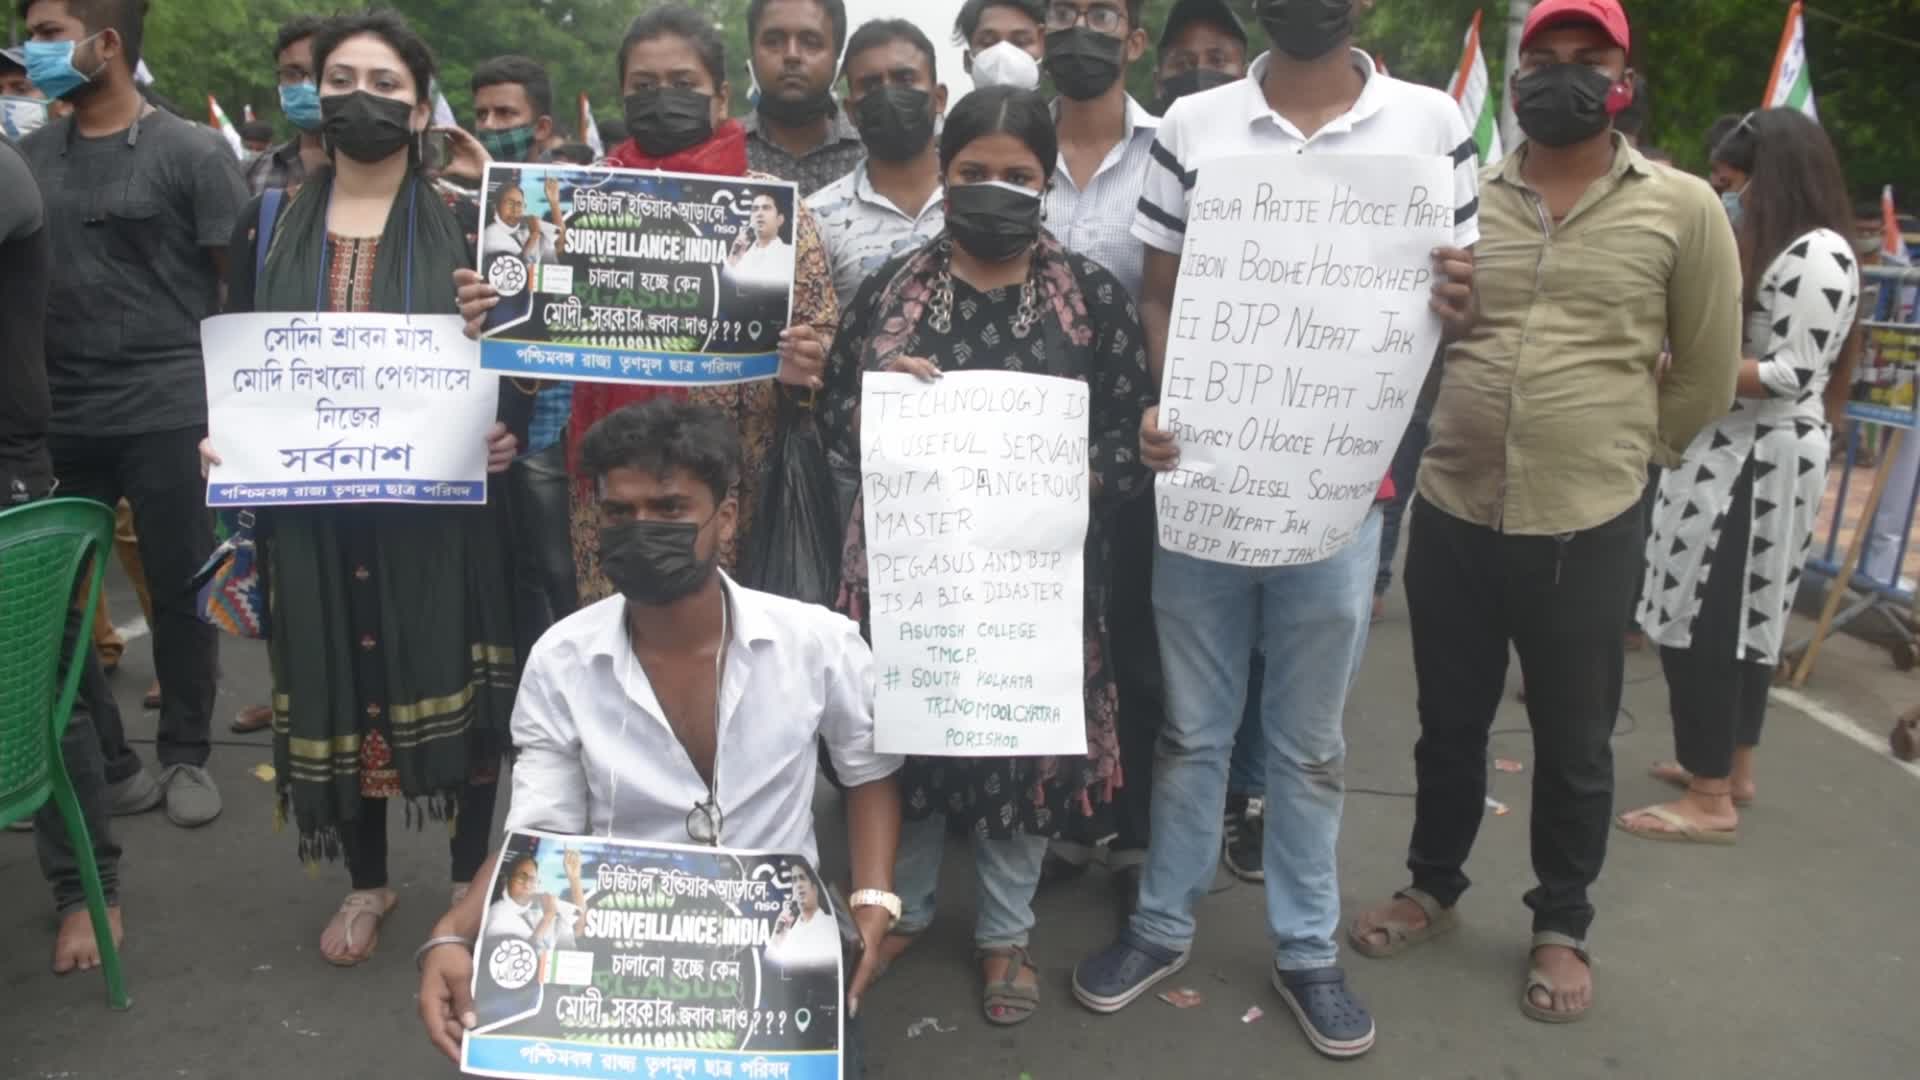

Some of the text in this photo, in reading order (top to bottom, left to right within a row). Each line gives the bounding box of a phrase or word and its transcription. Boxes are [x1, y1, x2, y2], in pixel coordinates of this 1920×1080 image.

[573, 188, 623, 213] ডিজিটাল
[1328, 184, 1397, 227] HOCCE
[1403, 186, 1455, 228] RAPE
[564, 228, 729, 264] SURVEILLANCE INDIA
[588, 267, 634, 289] চালানো
[640, 271, 669, 293] হচ্ছে
[674, 274, 701, 295] কেন
[265, 317, 321, 352] সেদিন
[648, 314, 678, 335] জবাব
[1176, 299, 1415, 354] EI BJP NIPAT JAK
[233, 358, 470, 392] মোদি লিখলো পেগসাসে
[516, 345, 575, 368] পশ্চিমবঙ্গ
[619, 354, 662, 375] তৃণমূল
[669, 358, 694, 374] ছাত্র
[1167, 357, 1409, 410] EI BJP NIPAT JAK
[316, 397, 381, 430] নিজের
[872, 386, 1087, 422] TECHNOLOGY IS
[279, 439, 414, 472] সর্বনাশ
[867, 436, 884, 462] A
[1000, 432, 1088, 476] SERVANT
[219, 483, 288, 499] পশ্চিমবঙ্গ
[333, 483, 380, 499] তৃণমূল
[386, 483, 416, 497] ছাত্র
[865, 466, 1084, 504] BUT A DANGEROUS
[875, 508, 973, 540] MASTER
[1184, 499, 1223, 527] BJP
[1223, 506, 1276, 532] NIPAT
[1280, 509, 1312, 534] JAK
[1187, 532, 1221, 551] BJP
[1227, 540, 1280, 562] NIPAT
[872, 552, 974, 584] PEGASUS
[880, 581, 1063, 614] IS A BIG DISASTER
[900, 622, 1037, 640] ASUTOSH COLLEGE
[912, 668, 960, 688] SOUTH
[977, 671, 1033, 691] KOLKATA
[585, 909, 771, 945] SURVEILLANCE INDIA
[611, 954, 665, 977] চালানো
[672, 957, 704, 981] হচ্ছে
[710, 961, 739, 981] কেন
[680, 1006, 714, 1028] জবাব
[645, 1055, 696, 1079] তৃণমূল
